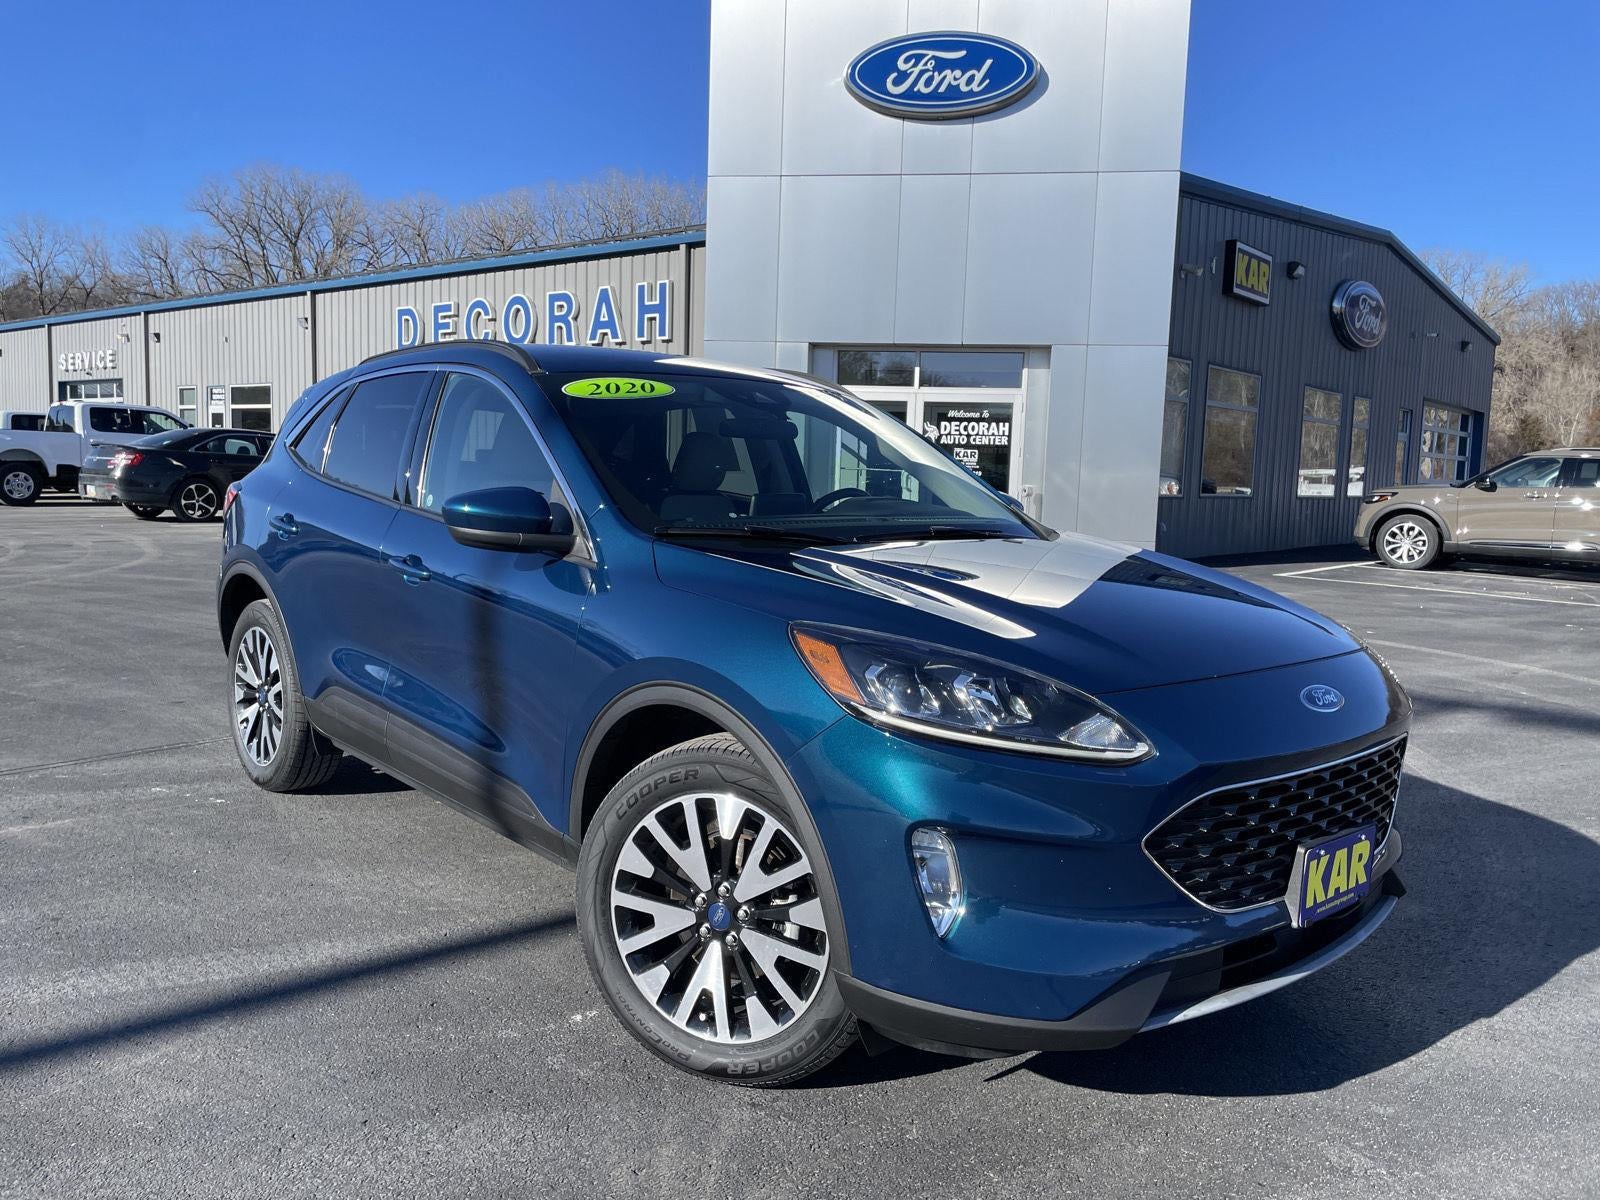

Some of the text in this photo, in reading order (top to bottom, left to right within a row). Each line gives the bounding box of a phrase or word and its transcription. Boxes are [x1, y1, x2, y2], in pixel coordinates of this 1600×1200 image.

[886, 50, 993, 95] Ford
[1236, 252, 1270, 295] KAR
[396, 280, 672, 349] DECORAH
[1355, 294, 1382, 335] Ford
[58, 349, 114, 370] SERVICE
[587, 381, 656, 396] 2020
[940, 421, 1010, 436] DECORAH
[947, 409, 990, 418] Welcome To
[940, 435, 1009, 446] AUTO CENTER
[954, 450, 977, 459] KAR
[1311, 688, 1338, 706] Ford
[615, 768, 700, 821] COOPER
[1305, 839, 1371, 909] KAR
[726, 1028, 820, 1075] COOPER
